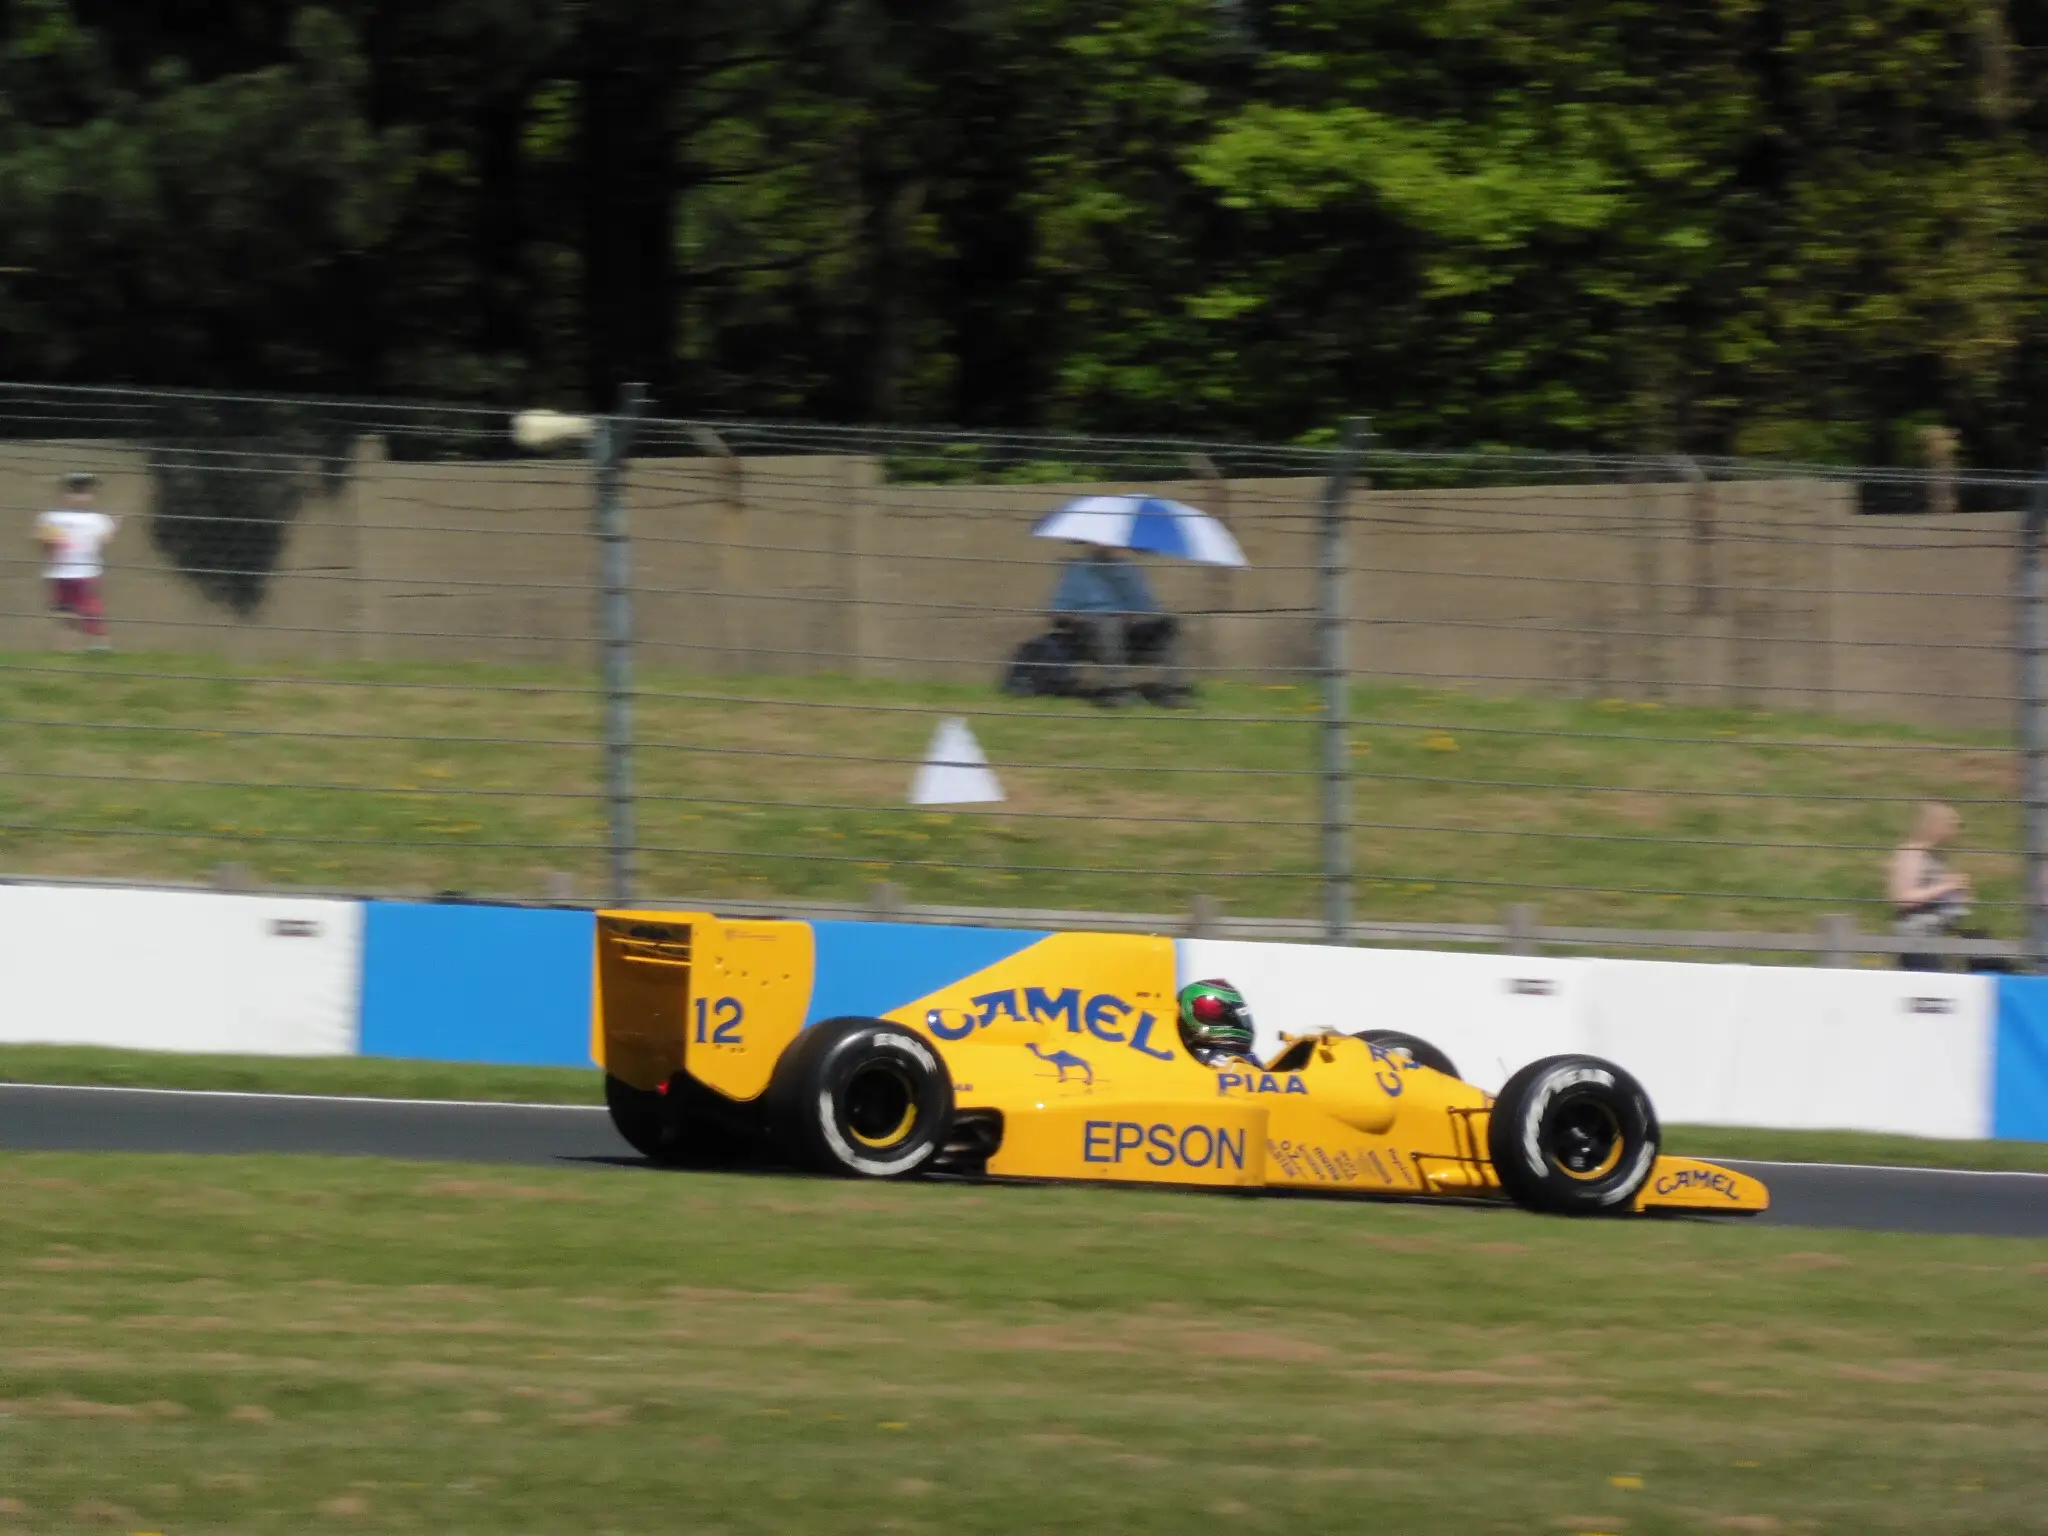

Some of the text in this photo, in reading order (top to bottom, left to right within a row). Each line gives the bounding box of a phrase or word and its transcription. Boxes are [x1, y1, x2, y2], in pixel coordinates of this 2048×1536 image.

[695, 996, 743, 1043] 12
[926, 985, 1175, 1061] CAMEL
[1217, 1072, 1309, 1097] PIAA
[1083, 1119, 1246, 1170] EPSON
[1656, 1169, 1740, 1200] CAMEL
